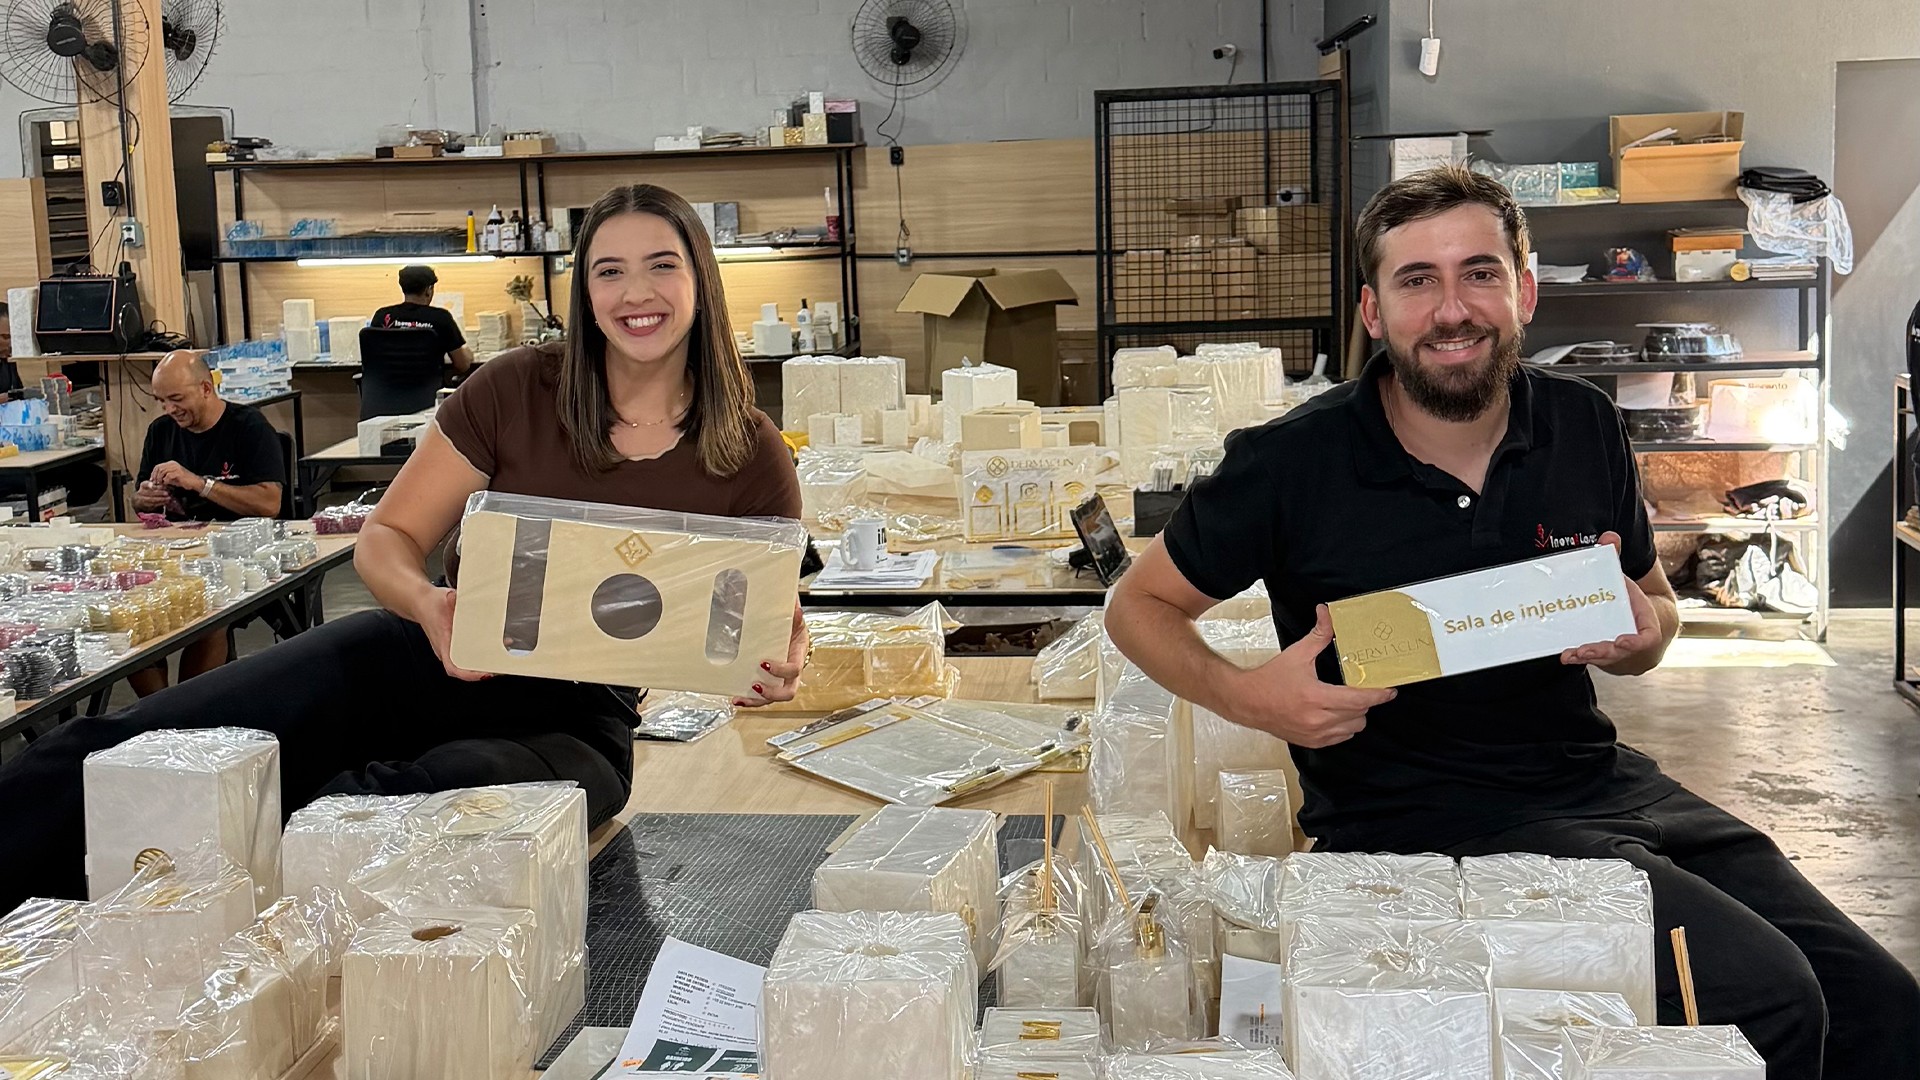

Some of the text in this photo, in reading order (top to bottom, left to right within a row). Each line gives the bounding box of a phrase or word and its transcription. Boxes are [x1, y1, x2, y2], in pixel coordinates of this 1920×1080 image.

[1444, 588, 1617, 634] Sala de injetáveis
